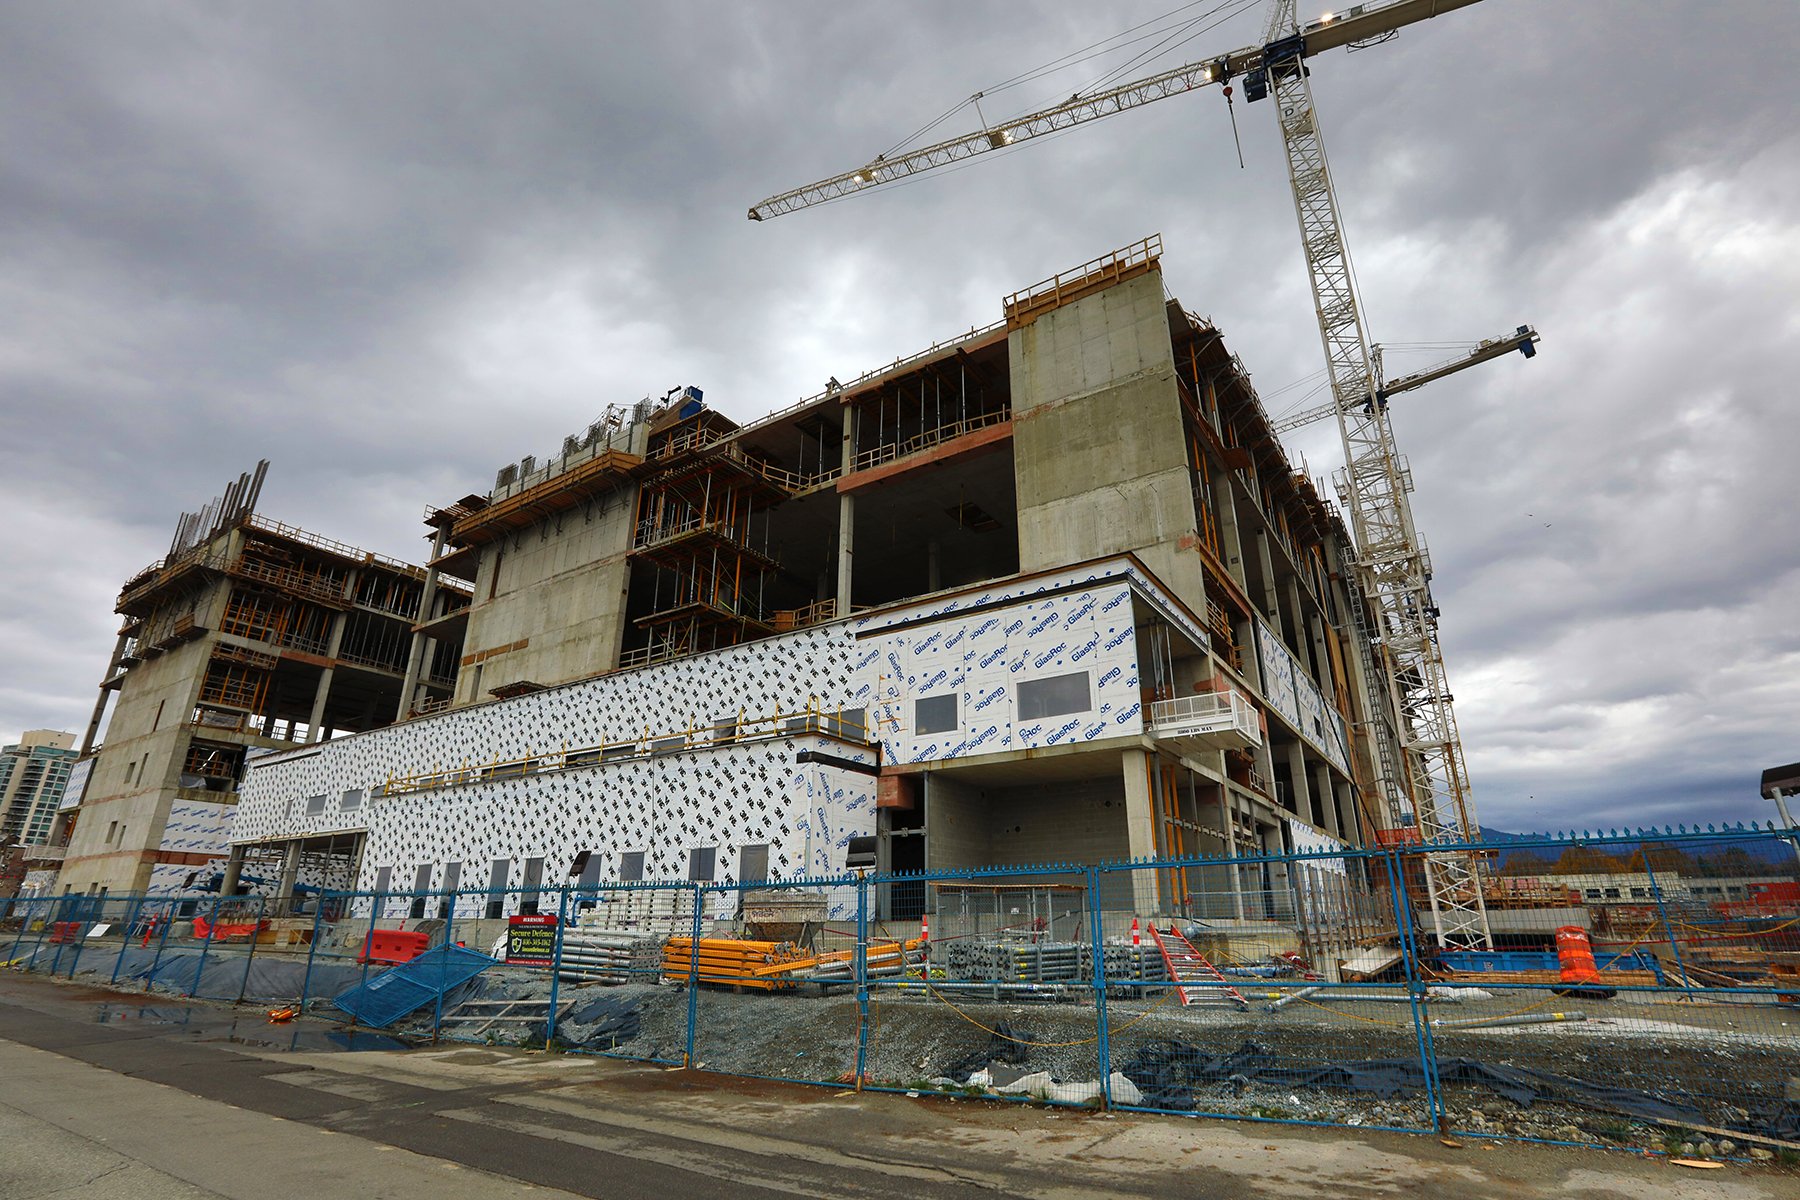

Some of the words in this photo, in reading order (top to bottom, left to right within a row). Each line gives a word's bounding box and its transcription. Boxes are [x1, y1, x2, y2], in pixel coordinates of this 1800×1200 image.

[1027, 612, 1059, 638] GlasRoc
[914, 631, 942, 655] GlasRoc
[1035, 642, 1066, 669] GlasRoc
[888, 653, 904, 682] GlasRoc
[919, 670, 946, 694] GlasRoc
[975, 687, 1005, 711] GlasRoc
[967, 726, 997, 750] GlasRoc
[1046, 719, 1080, 745] GlasRoc
[817, 808, 831, 845] GlasRoc
